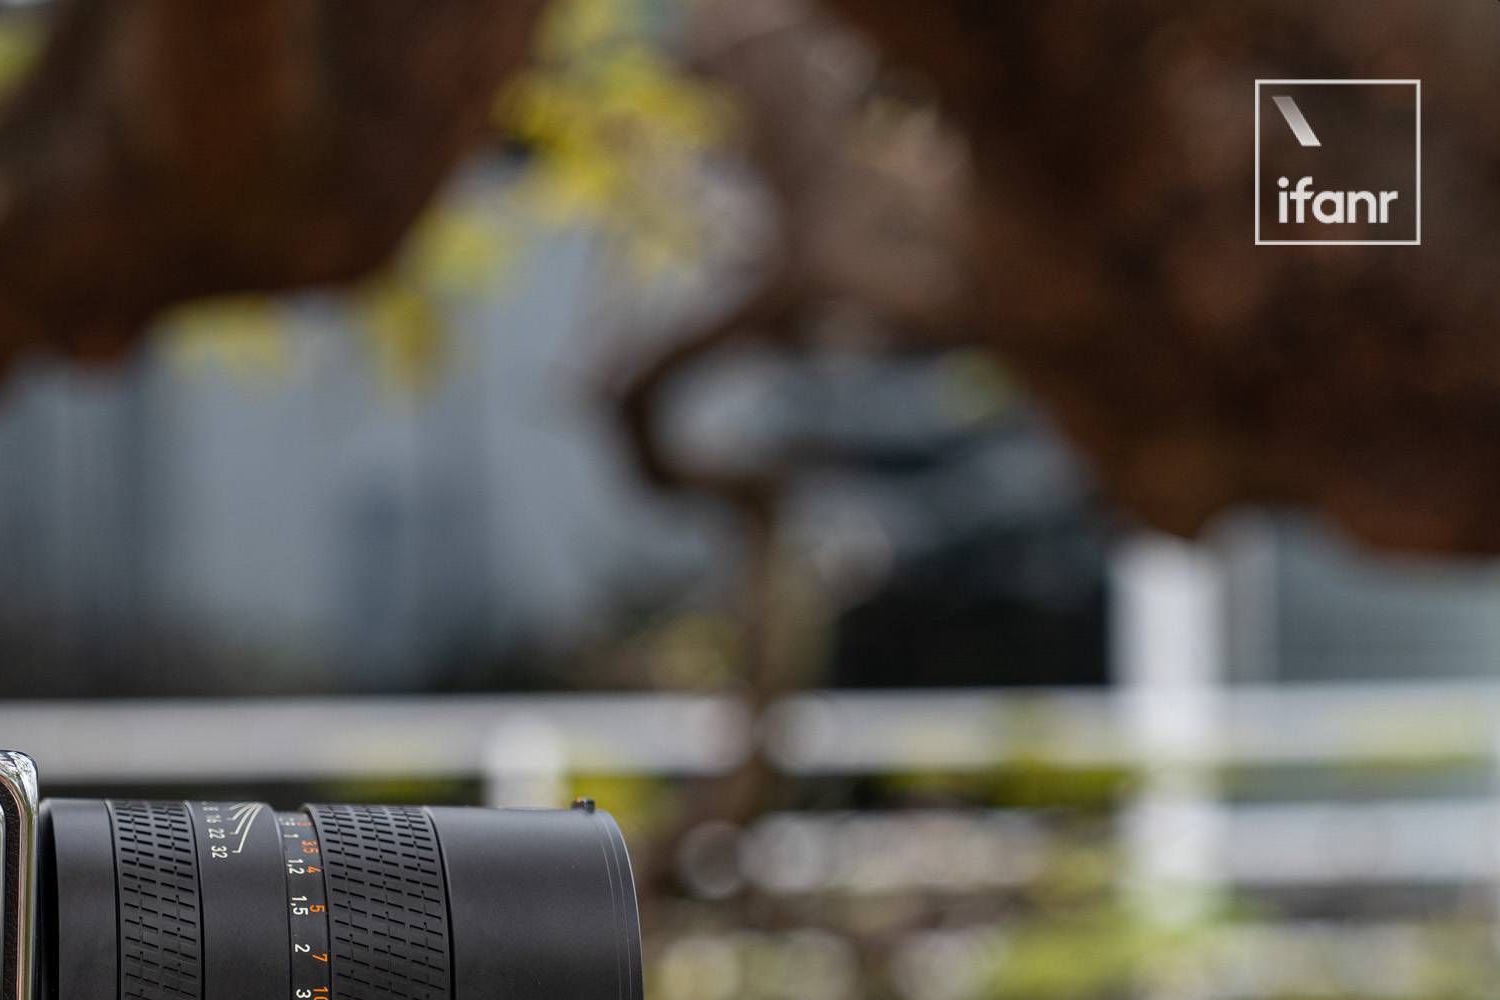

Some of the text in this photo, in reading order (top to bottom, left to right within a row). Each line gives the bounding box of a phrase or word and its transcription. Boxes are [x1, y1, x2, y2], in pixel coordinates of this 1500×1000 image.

[208, 828, 226, 840] 22
[211, 845, 228, 859] 32
[288, 858, 305, 875] 1,2
[307, 865, 324, 874] 4
[291, 895, 308, 915] 1,5
[309, 904, 325, 913] 5
[294, 944, 310, 953] 2
[312, 953, 328, 962] 7
[296, 989, 311, 999] 3
